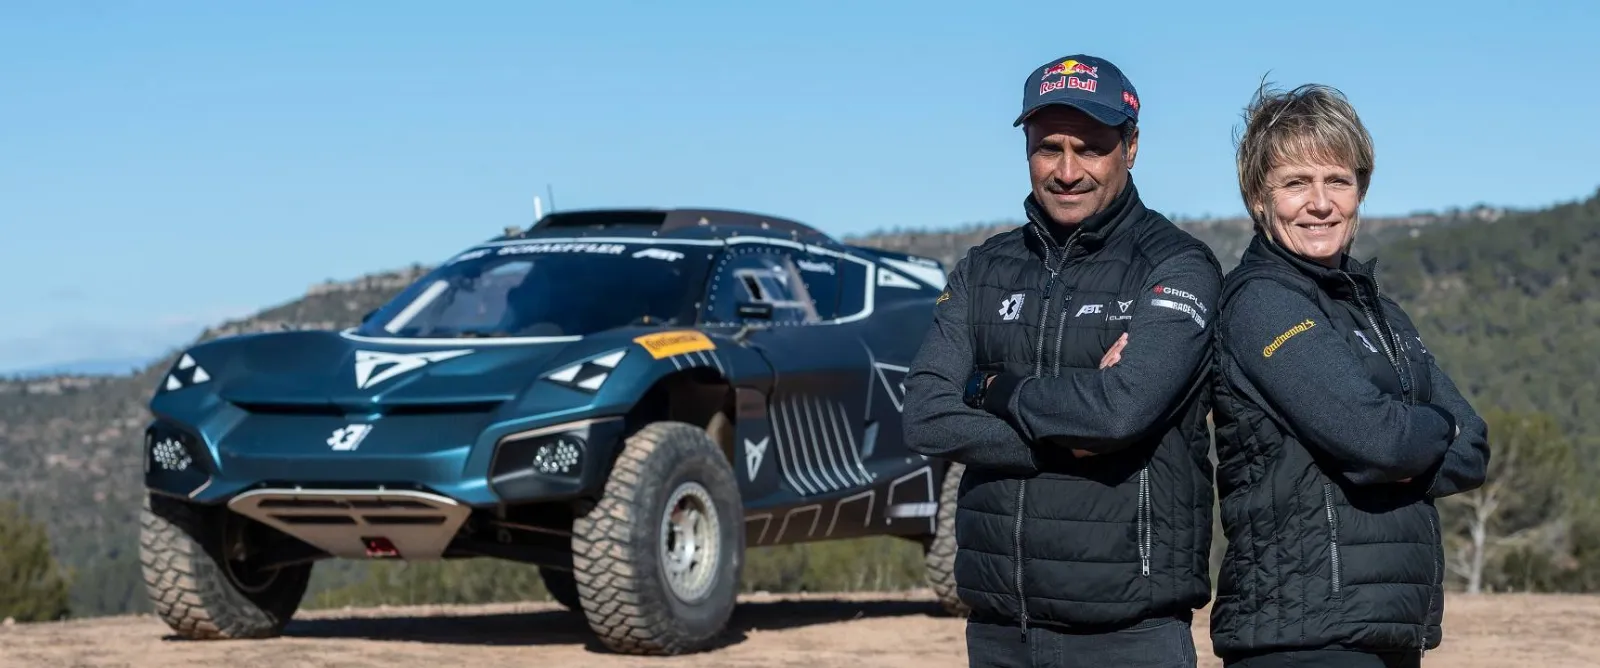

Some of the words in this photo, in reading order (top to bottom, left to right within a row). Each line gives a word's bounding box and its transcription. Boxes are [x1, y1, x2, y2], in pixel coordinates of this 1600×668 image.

[1040, 76, 1066, 95] Red
[1068, 77, 1097, 92] Bull
[1263, 321, 1307, 357] Continental
